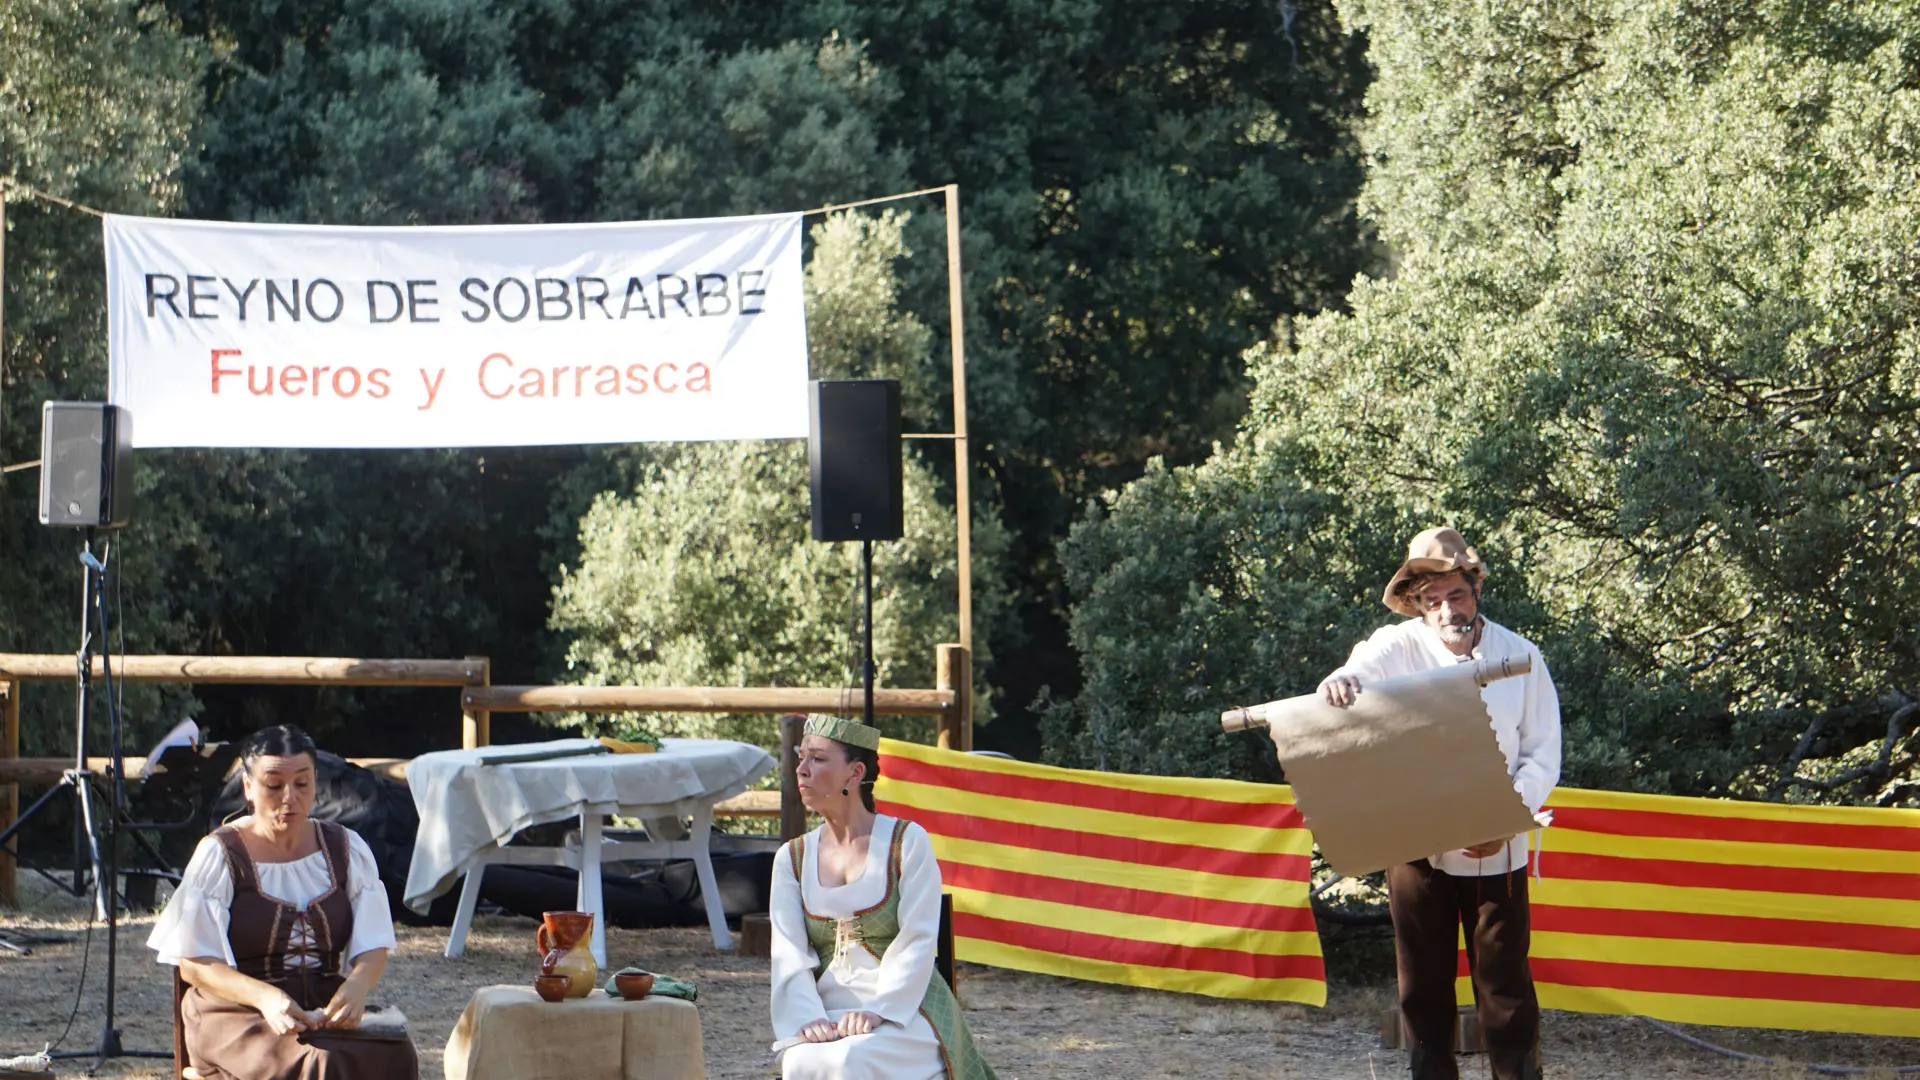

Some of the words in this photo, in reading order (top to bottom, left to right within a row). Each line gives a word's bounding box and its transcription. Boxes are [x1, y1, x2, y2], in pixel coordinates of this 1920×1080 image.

[144, 273, 344, 323] REYNO
[366, 279, 440, 323] DE
[459, 270, 767, 323] SOBRARBE
[209, 349, 391, 399] Fueros
[418, 366, 445, 411] y
[477, 352, 712, 400] Carrasca
